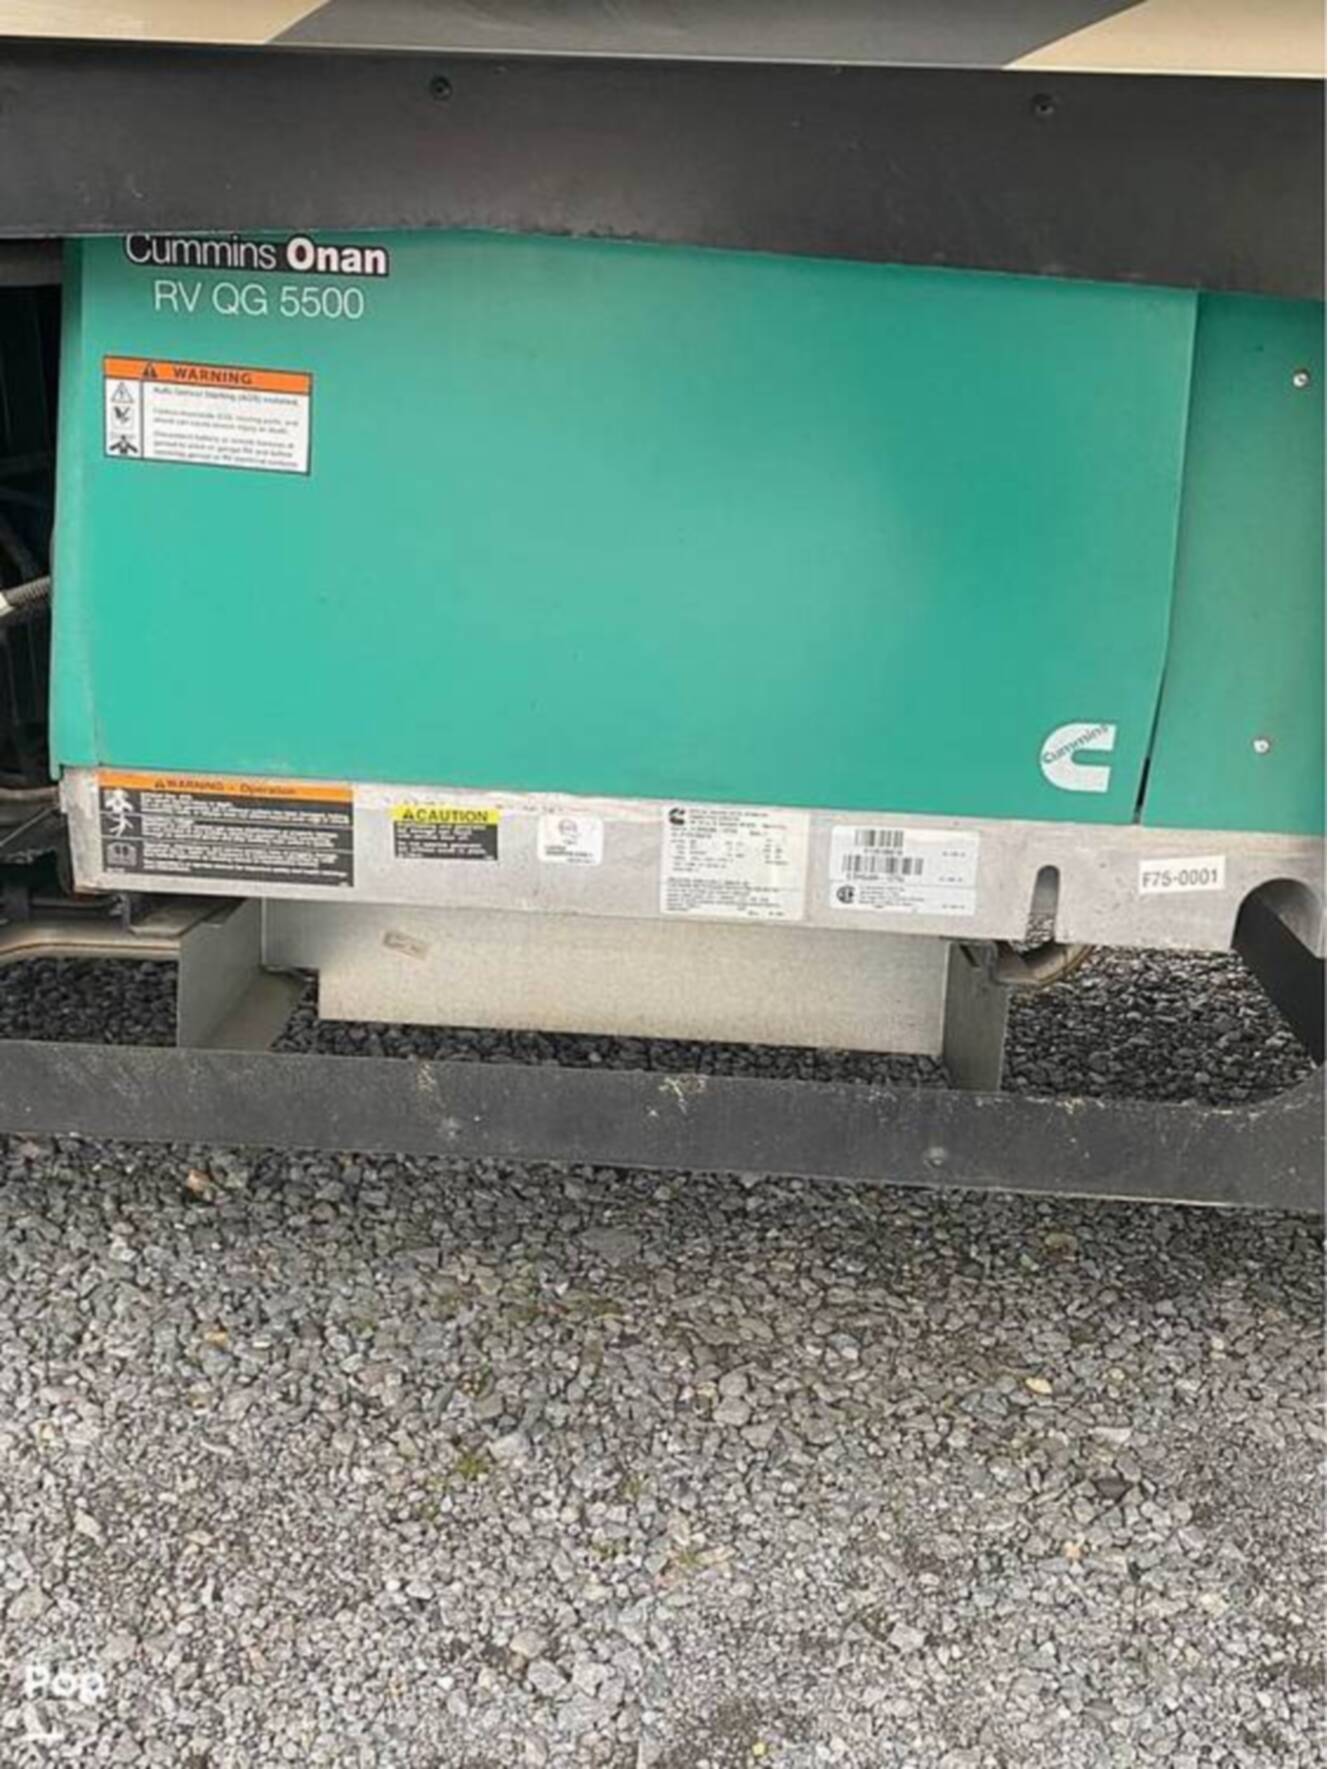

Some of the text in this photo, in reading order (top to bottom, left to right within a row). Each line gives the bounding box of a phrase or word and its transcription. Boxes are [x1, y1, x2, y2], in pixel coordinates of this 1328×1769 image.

[125, 233, 387, 275] Cummins Onan
[154, 280, 364, 319] RV QG 5500
[173, 367, 252, 385] WARNING
[1042, 724, 1109, 765] Cummins
[416, 808, 489, 822] CAUTION
[1141, 868, 1218, 889] F75-0001
